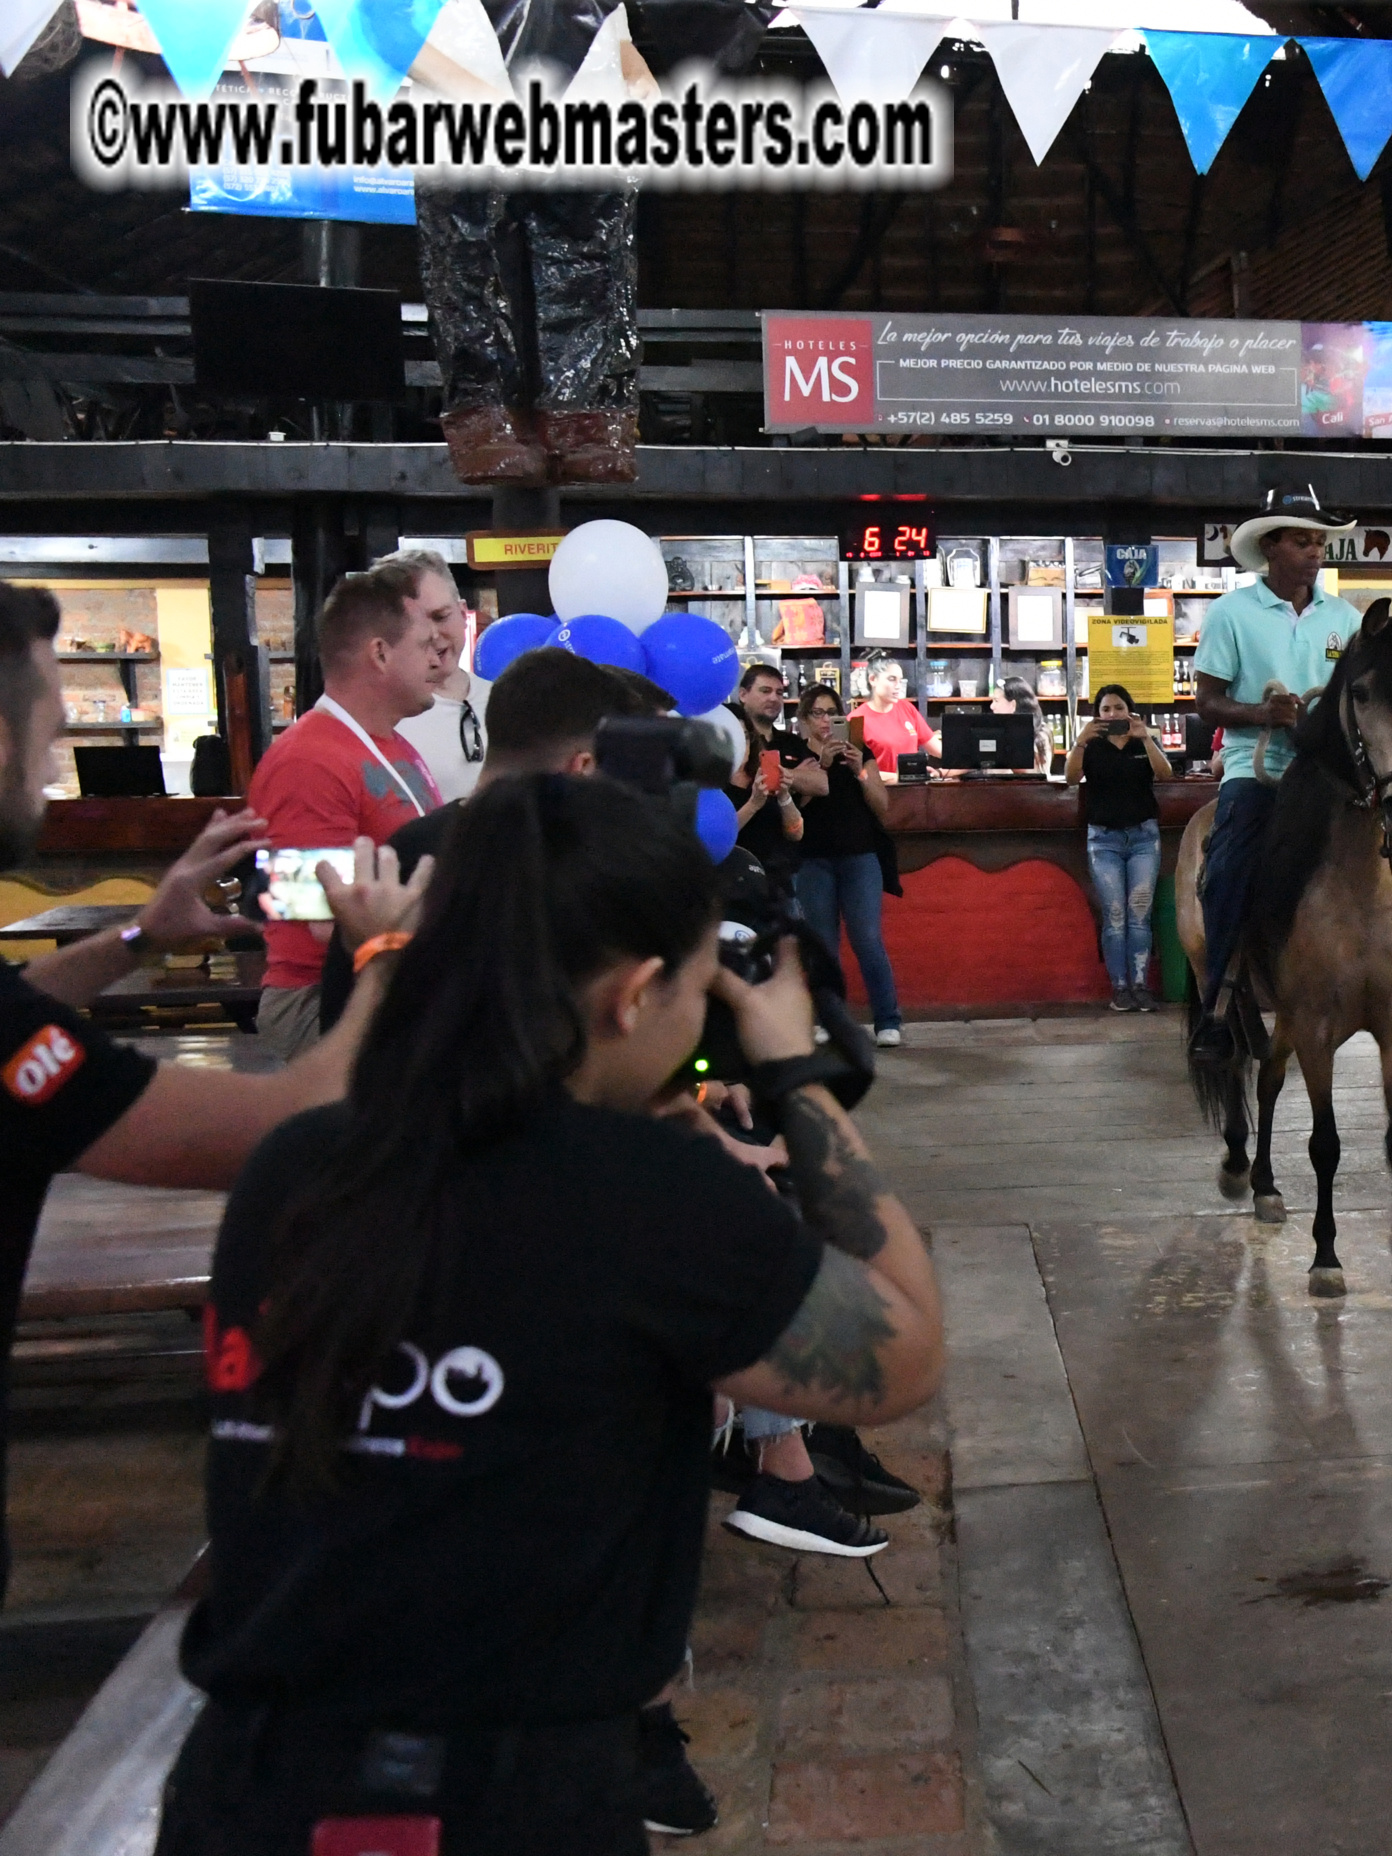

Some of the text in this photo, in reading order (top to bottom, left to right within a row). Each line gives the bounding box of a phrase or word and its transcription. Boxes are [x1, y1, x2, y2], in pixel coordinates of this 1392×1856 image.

[784, 340, 857, 350] HOTELES
[878, 321, 1297, 357] La mejor opción para tus viajes de trabajo o placer
[900, 358, 938, 369] MEJOR
[941, 358, 983, 369] PRECIO
[986, 359, 1066, 371] GARANTIZADO
[1069, 361, 1093, 371] POR
[1097, 361, 1133, 372] MEDIO
[1136, 363, 1151, 372] DE
[1155, 363, 1205, 373] NUESTRA
[1251, 365, 1276, 375] WEB
[784, 356, 859, 403] MS
[1000, 377, 1181, 395] www.hotelesms.com
[887, 412, 1013, 426] +57(2) 485 5259
[1032, 413, 1155, 427] 01 8000 910098
[1173, 416, 1300, 428] reservas@hotelesms.com
[1321, 412, 1344, 424] Cali
[1368, 416, 1386, 427] San
[863, 525, 928, 552] 6 24
[504, 542, 558, 556] RIVERIT
[1116, 548, 1147, 560] CAJA
